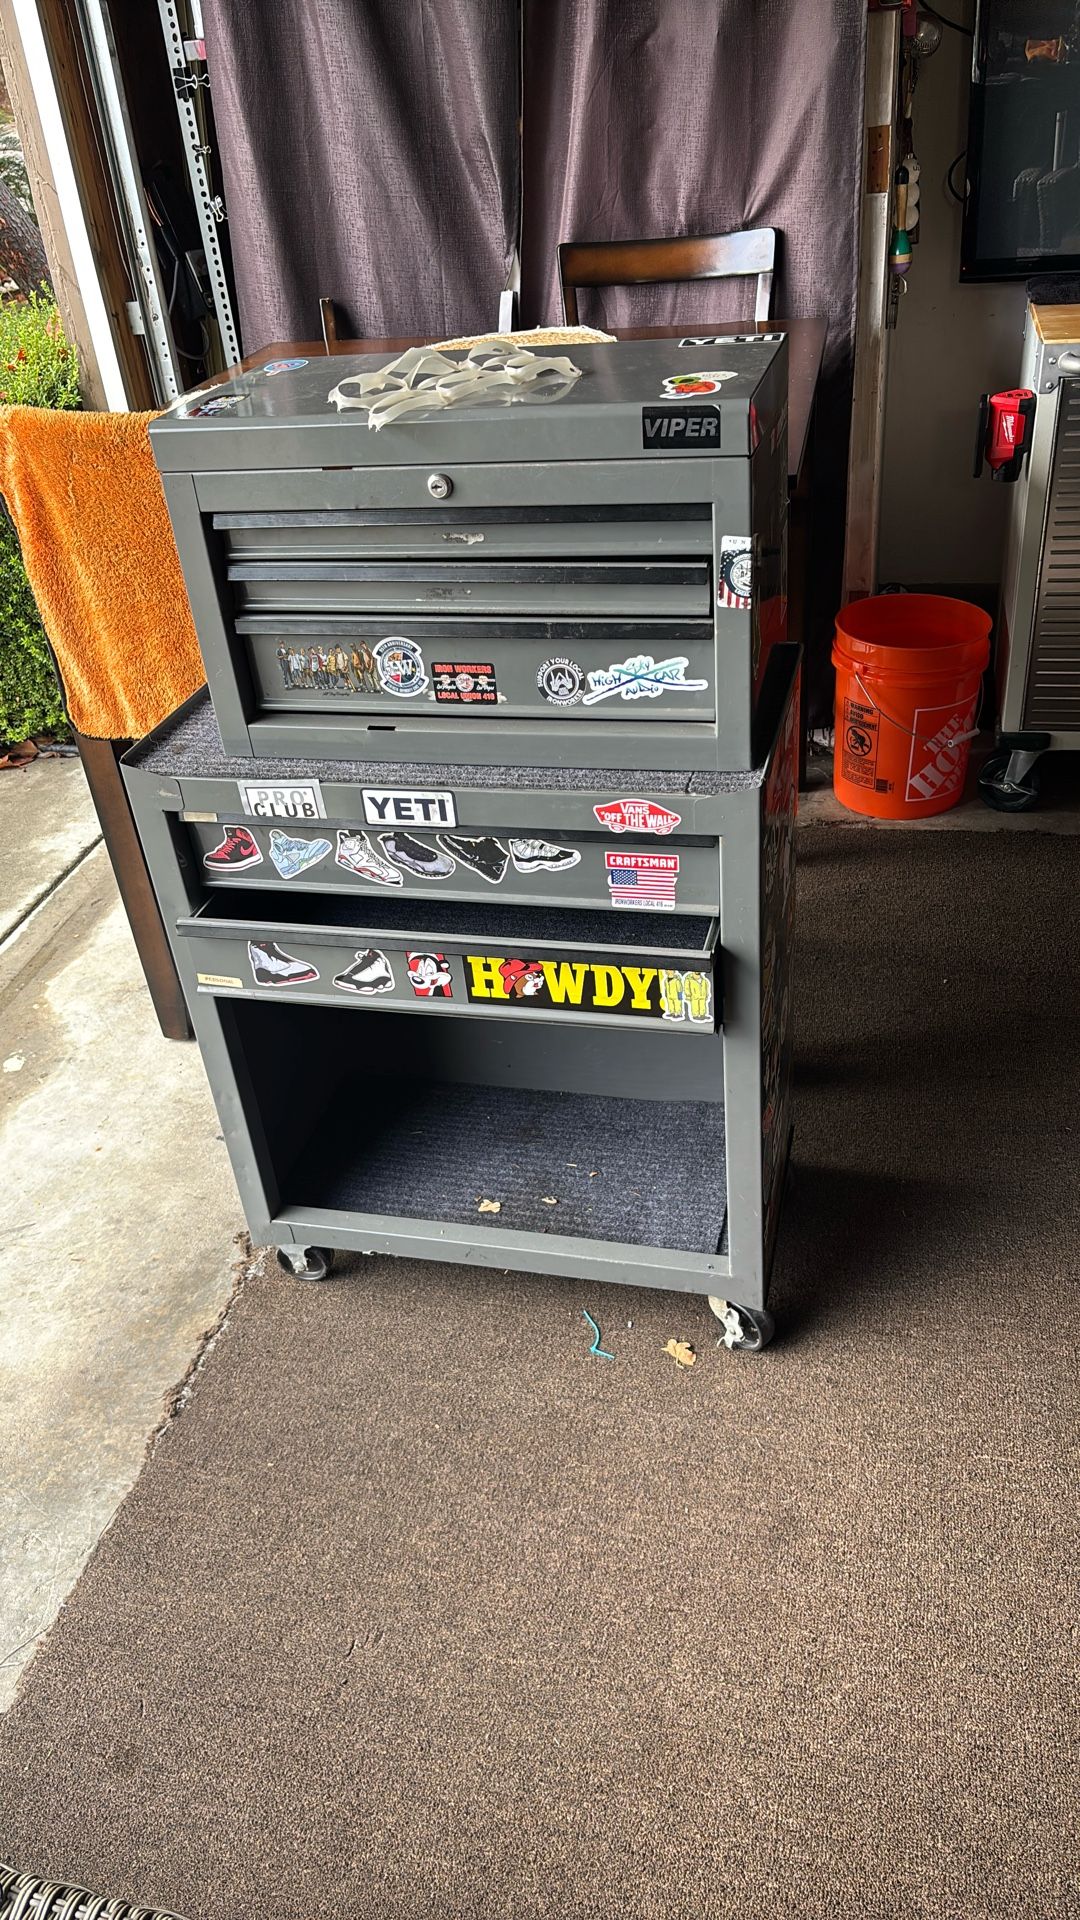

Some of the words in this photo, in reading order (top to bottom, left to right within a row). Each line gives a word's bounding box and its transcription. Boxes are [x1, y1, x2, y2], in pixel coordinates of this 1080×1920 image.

[689, 334, 773, 345] YETI
[644, 417, 718, 438] VIPER
[434, 664, 453, 673] IRON
[454, 665, 492, 674] WORKERS
[536, 661, 551, 687] SUPPORT
[549, 657, 570, 665] YOUR
[569, 661, 585, 680] LOCAL
[437, 691, 459, 700] LOCAL
[460, 692, 482, 700] UNION
[850, 703, 874, 715] WARNING
[923, 713, 962, 754] THE
[257, 790, 305, 807] PRO
[254, 802, 316, 818] CLUB
[367, 796, 448, 822] YETI
[619, 802, 650, 815] VANS
[623, 813, 645, 828] THE
[609, 856, 676, 868] CRAFTSMAN
[614, 898, 643, 906] IRONWORKERS
